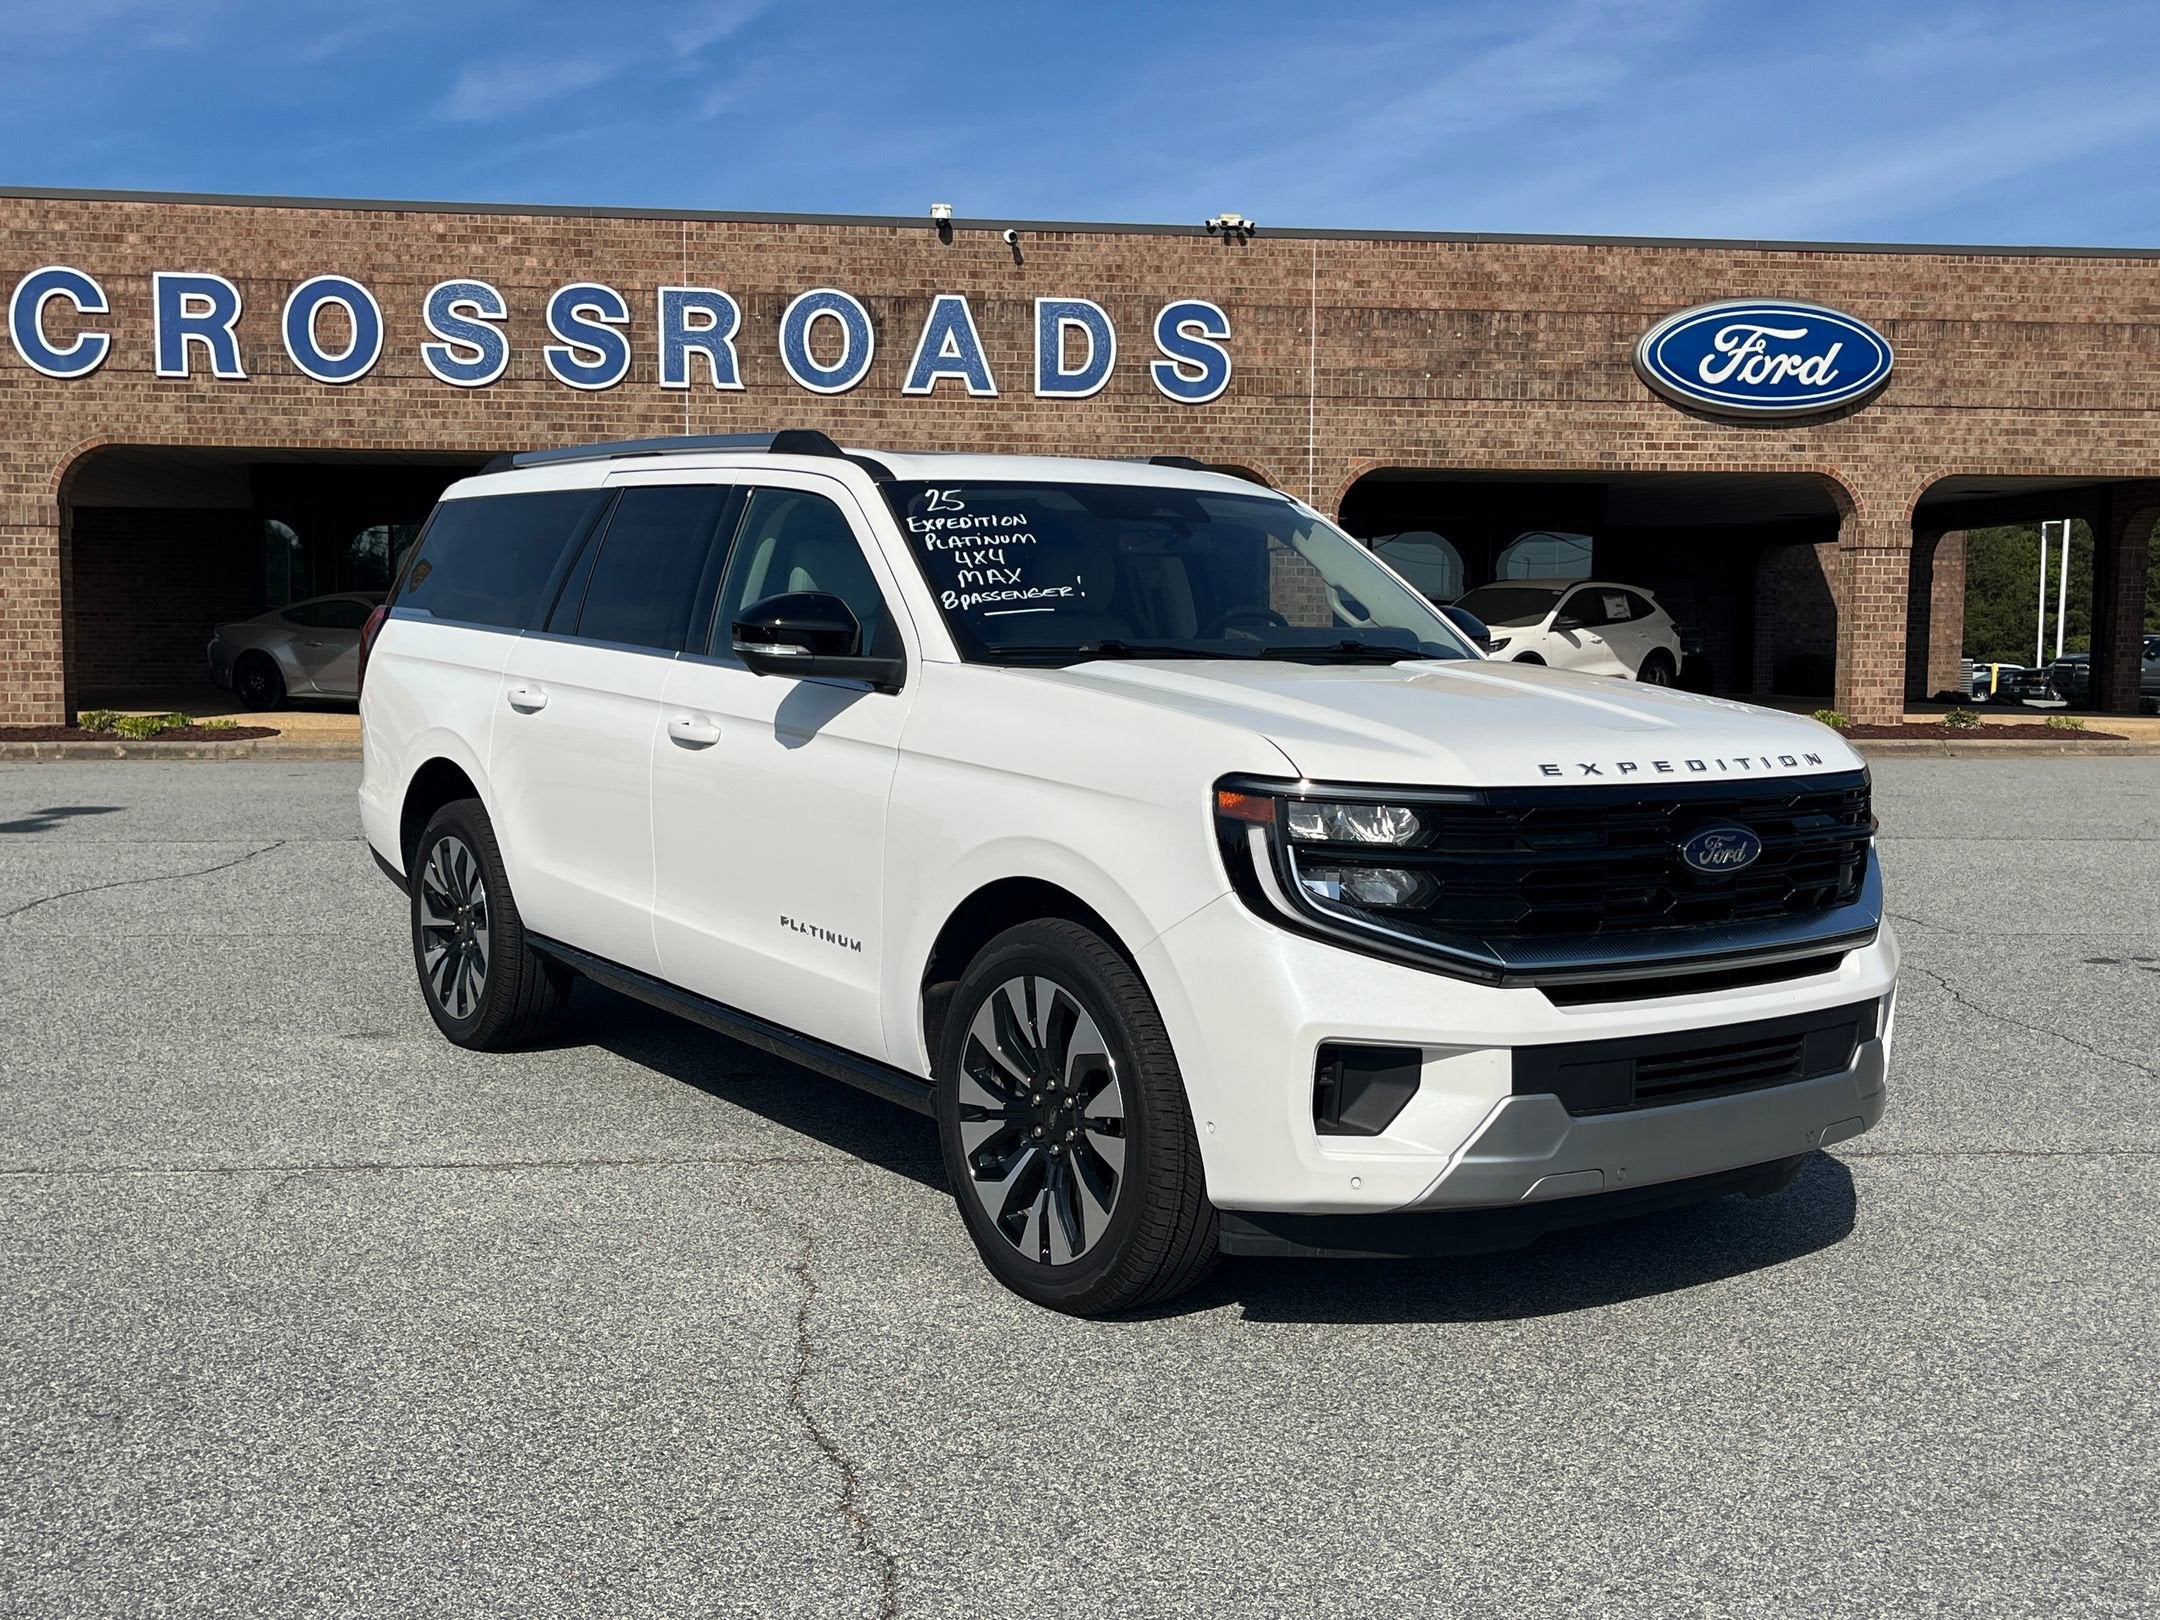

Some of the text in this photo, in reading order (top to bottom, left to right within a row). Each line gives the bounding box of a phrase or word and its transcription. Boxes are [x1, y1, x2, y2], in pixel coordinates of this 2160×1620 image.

[8, 265, 1232, 404] CROSSROADS
[1699, 324, 1843, 386] Ford
[925, 489, 965, 512] 25
[906, 514, 1027, 533] EXPEDITION
[925, 532, 1037, 550] PLATINUM
[955, 549, 1005, 568] 4X4
[957, 568, 1022, 588] MAX
[1537, 752, 1823, 777] EXPEDITION
[1699, 835, 1747, 865] Ford
[780, 915, 860, 952] PLATINUM
